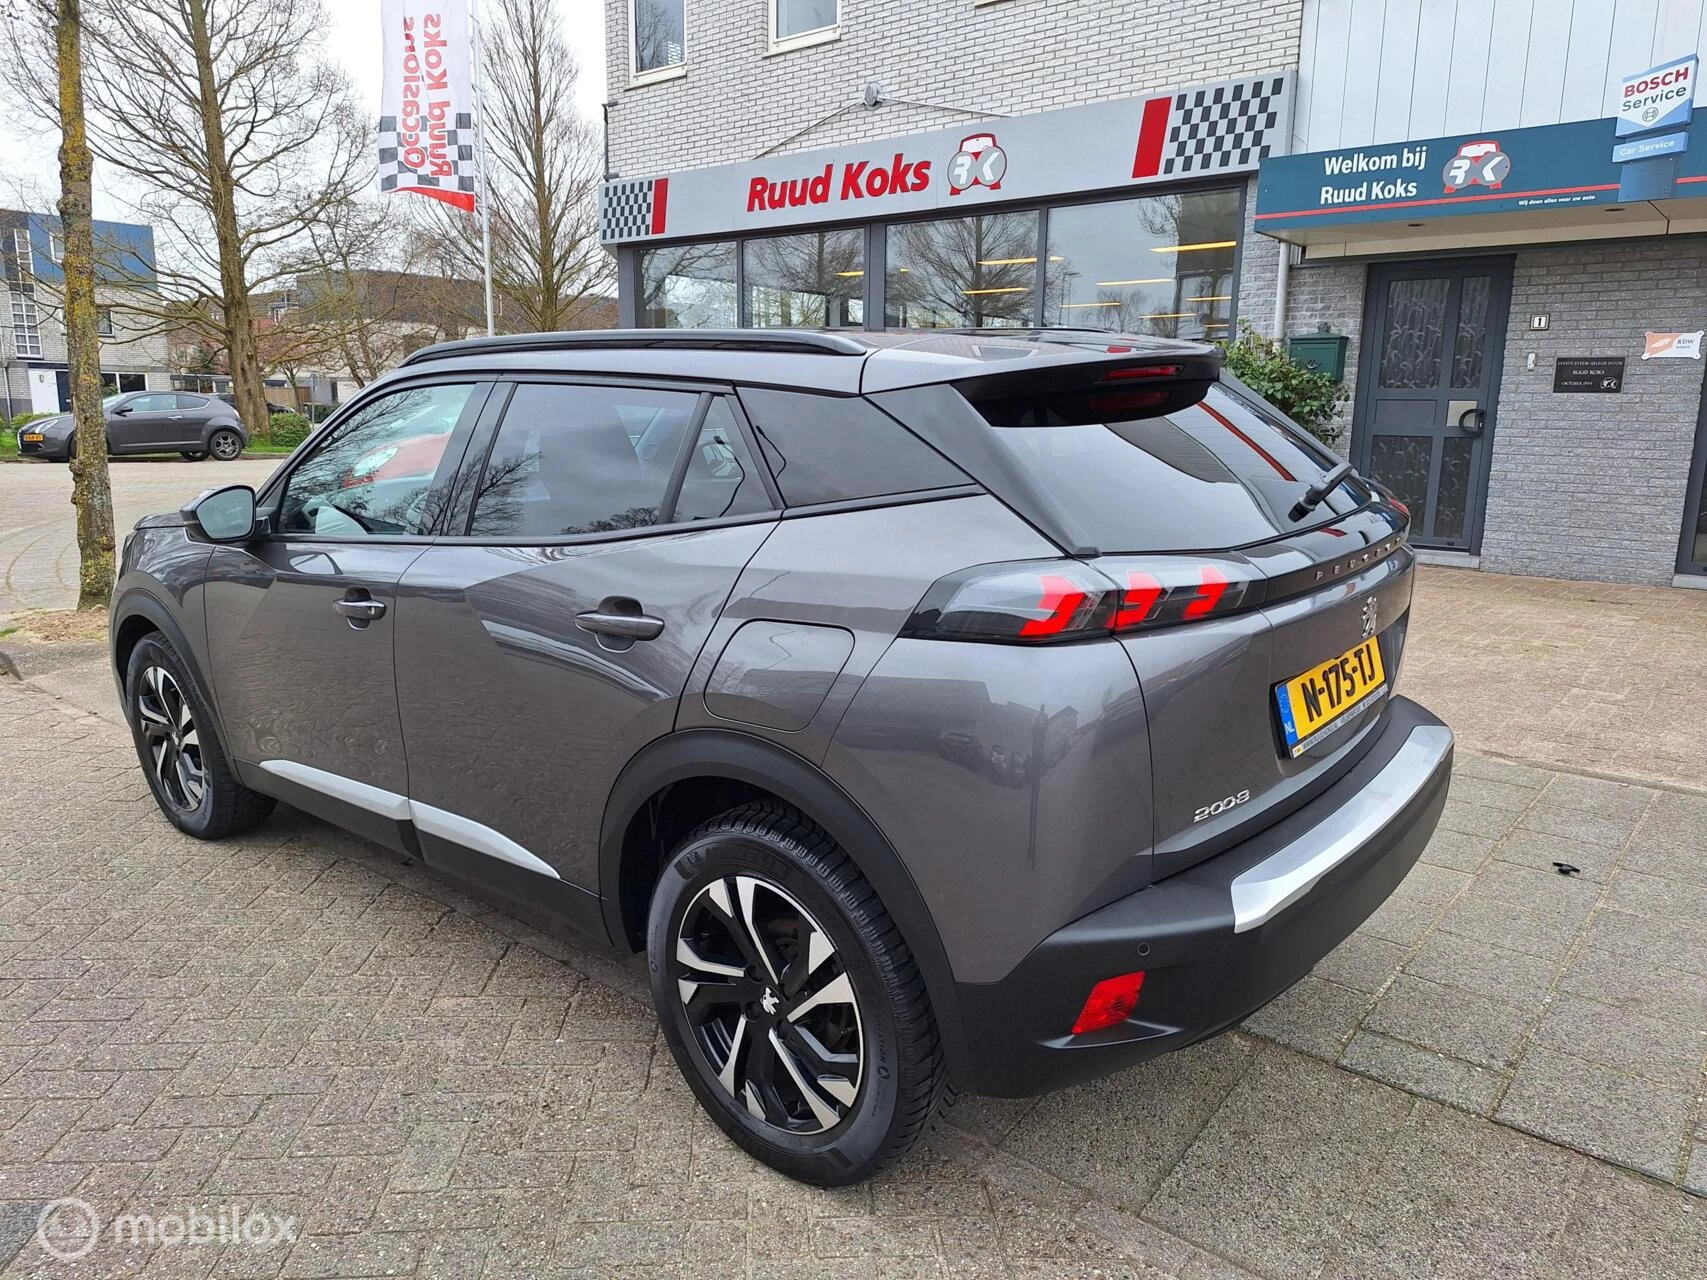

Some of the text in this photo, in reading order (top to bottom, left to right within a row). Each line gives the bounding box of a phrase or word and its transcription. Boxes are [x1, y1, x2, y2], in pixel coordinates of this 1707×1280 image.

[1623, 66, 1689, 99] BOSCH
[1621, 86, 1687, 112] Service
[1324, 146, 1427, 176] Welkom bij
[1619, 140, 1675, 156] Car Service
[746, 152, 932, 213] Ruud Koks
[1320, 178, 1418, 205] Ruud Koks
[1301, 643, 1376, 723] N-175-TJ
[1283, 721, 1296, 736] NL
[1193, 789, 1251, 823] 2008
